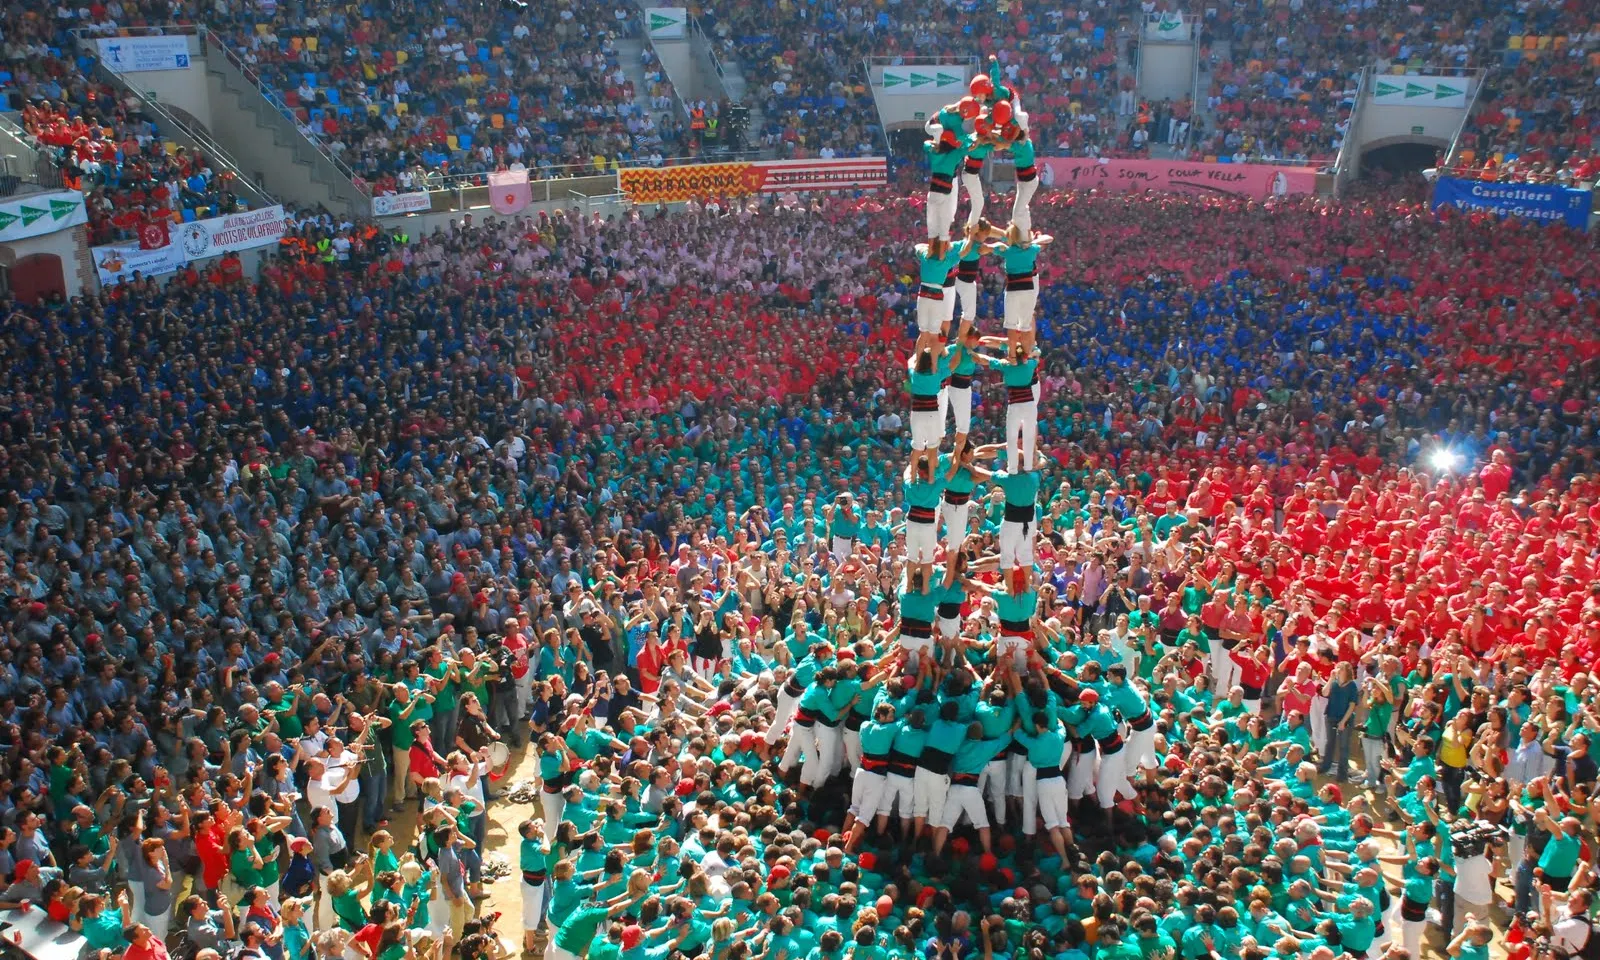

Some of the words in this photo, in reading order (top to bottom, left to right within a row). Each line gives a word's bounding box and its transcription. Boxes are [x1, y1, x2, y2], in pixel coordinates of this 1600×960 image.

[773, 170, 819, 184] SEMPRE
[1071, 165, 1109, 180] TOTS
[1208, 170, 1247, 181] VELLA
[626, 175, 735, 193] TARRAGONA
[1472, 185, 1552, 201] Castellers
[212, 228, 238, 247] XICOTS
[238, 227, 248, 242] DE
